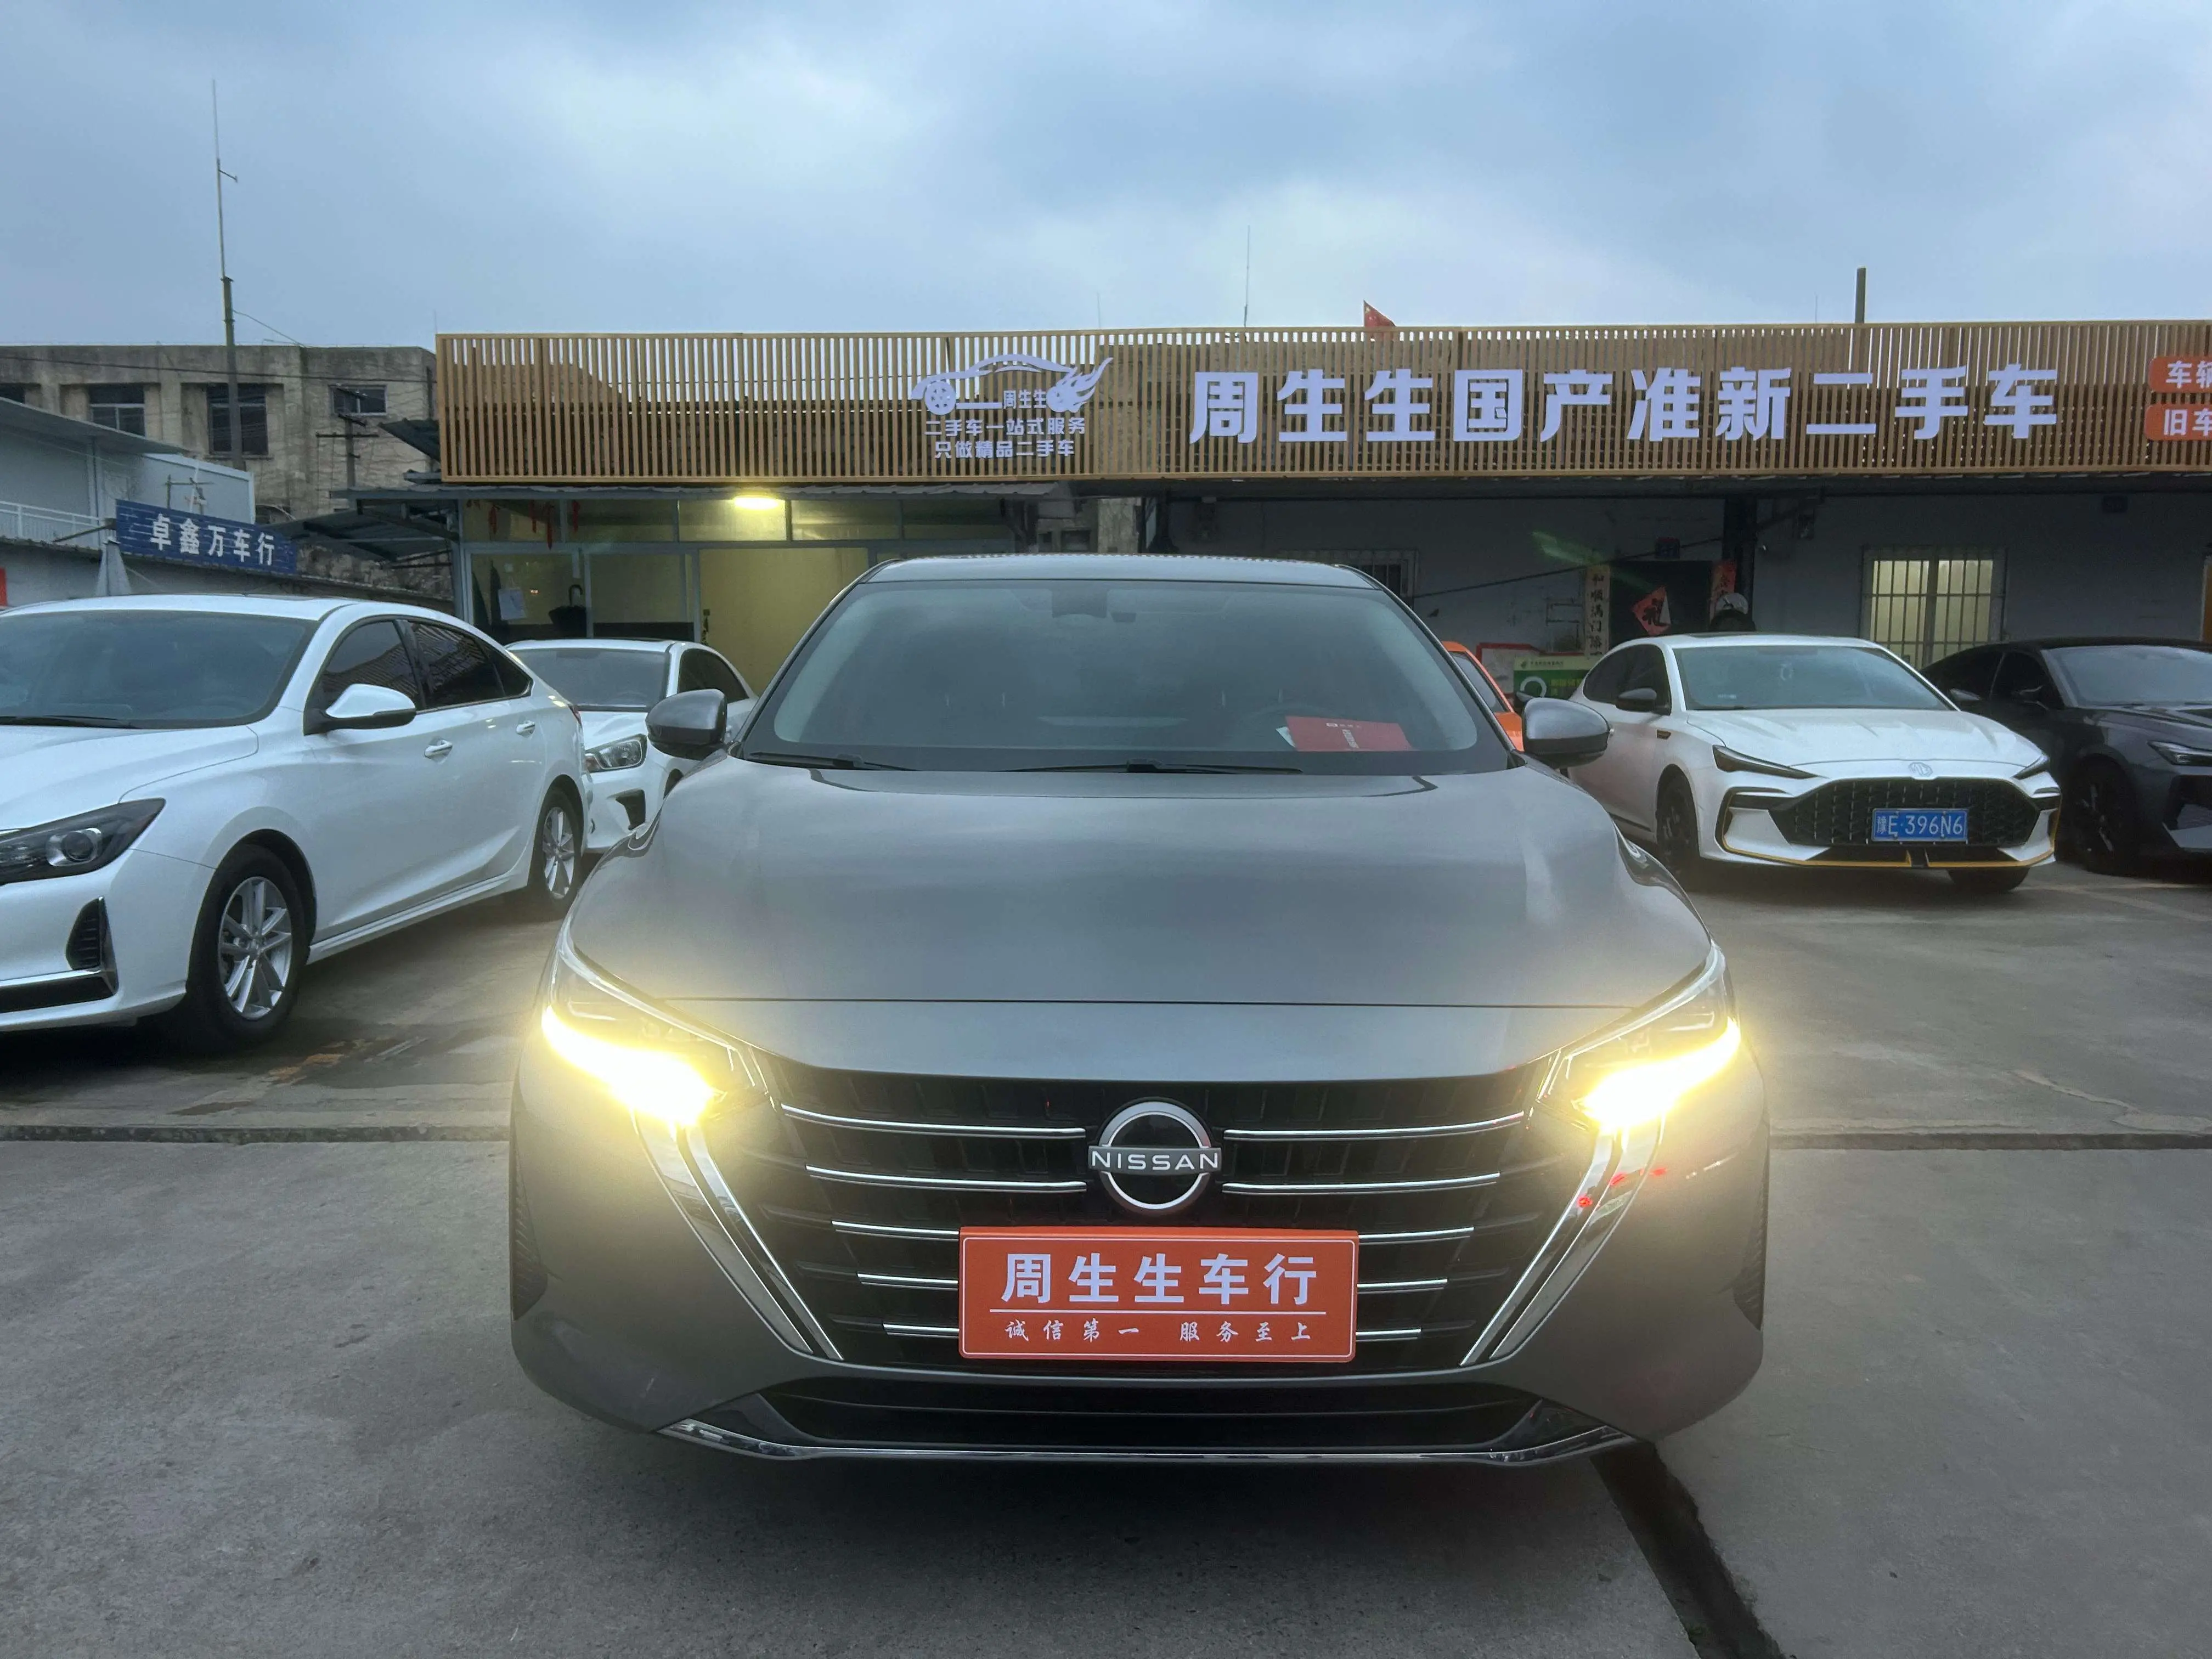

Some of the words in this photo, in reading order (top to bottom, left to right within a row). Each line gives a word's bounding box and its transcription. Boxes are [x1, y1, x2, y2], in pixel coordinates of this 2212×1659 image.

[1003, 388, 1047, 409] 周生生
[1189, 363, 2058, 444] 周生生国产准新二手车
[924, 417, 1085, 437] 二手车一站式服务
[2163, 408, 2212, 437] 旧车
[934, 439, 1074, 459] 只做精品二手车
[149, 512, 275, 566] 卓鑫万车行
[1091, 1150, 1218, 1171] NISSAN
[1001, 1251, 1317, 1305] 周生生车行
[1005, 1319, 1139, 1343] 诚信第一
[1180, 1321, 1311, 1342] 服务至上
